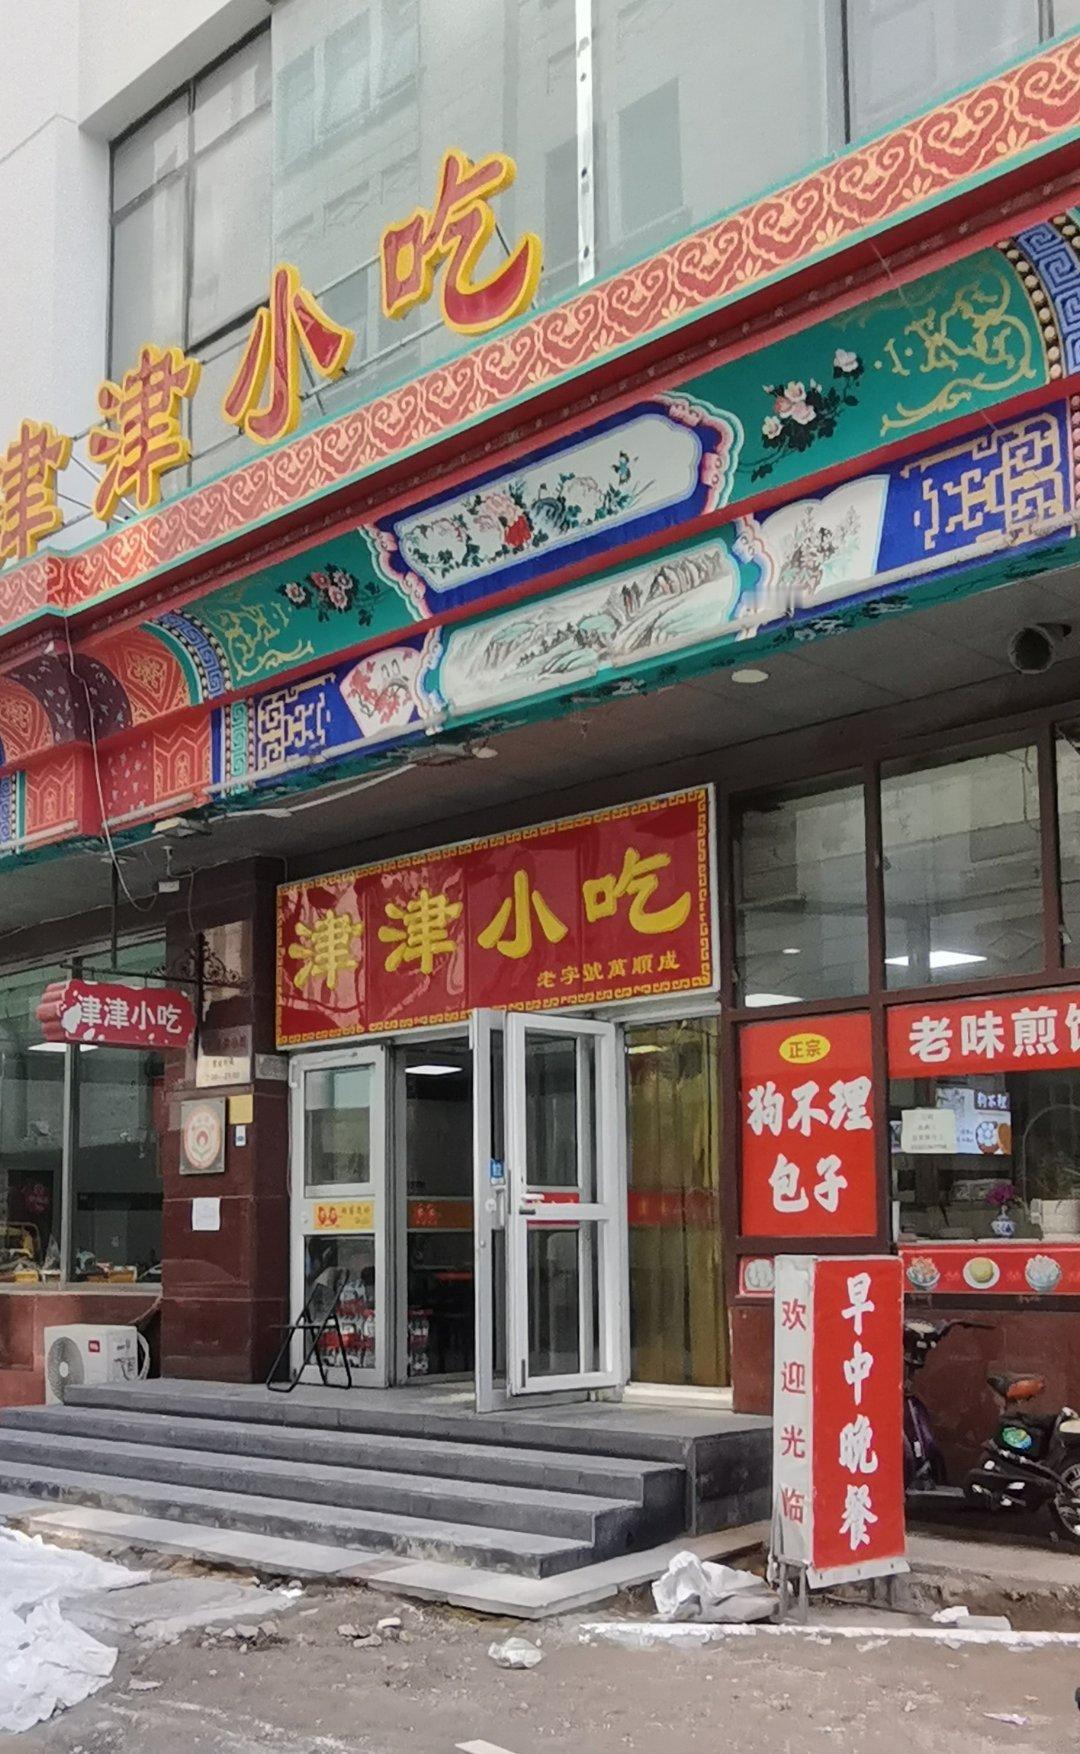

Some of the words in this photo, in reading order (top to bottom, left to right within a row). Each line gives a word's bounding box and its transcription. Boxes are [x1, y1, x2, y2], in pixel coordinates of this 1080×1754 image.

[288, 847, 692, 990] 津津小吃
[788, 1038, 822, 1059] 正宗
[747, 1076, 873, 1137] 狗不理
[768, 1153, 848, 1213] 包子
[780, 1300, 807, 1525] 欢迎光临
[838, 1271, 879, 1551] 早中晚餐
